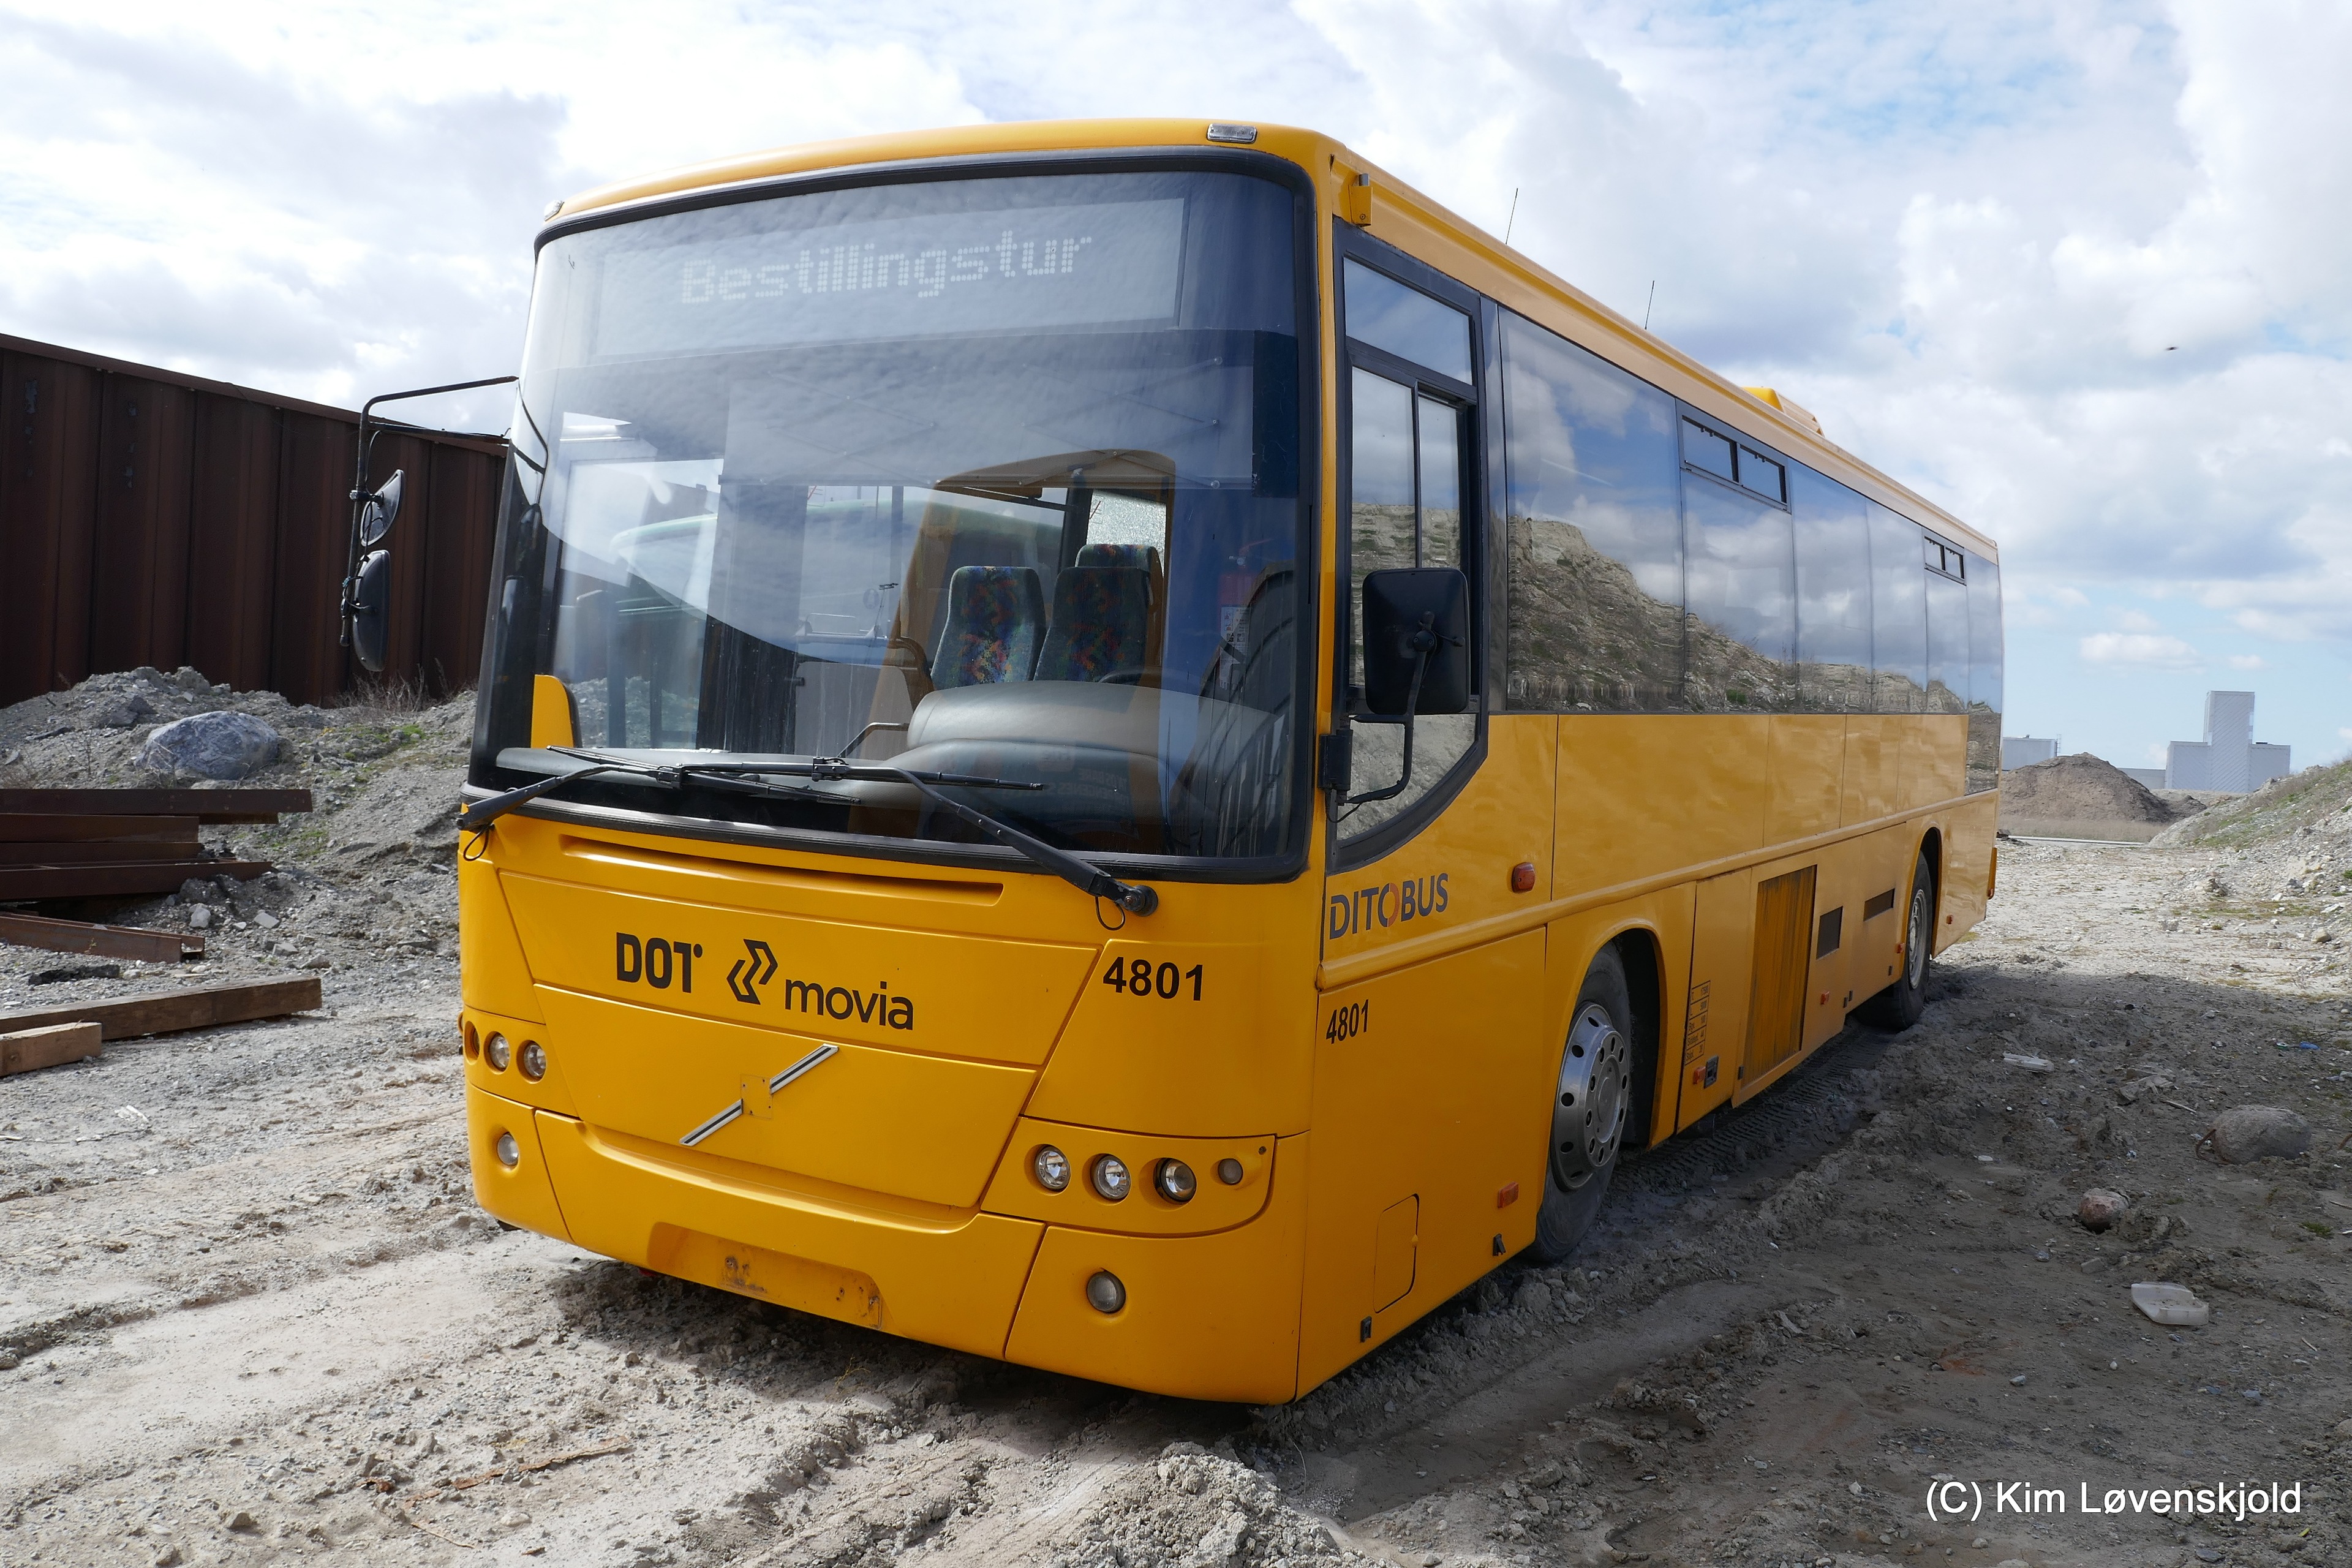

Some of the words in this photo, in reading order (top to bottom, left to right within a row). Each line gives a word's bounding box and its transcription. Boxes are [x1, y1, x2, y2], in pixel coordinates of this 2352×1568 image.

[682, 230, 1092, 304] Bestillingstur
[1329, 873, 1449, 940] DITOBUS
[616, 932, 692, 993] DOT
[1102, 957, 1204, 1001] 4801
[785, 979, 913, 1030] movia
[1325, 999, 1370, 1044] 4801
